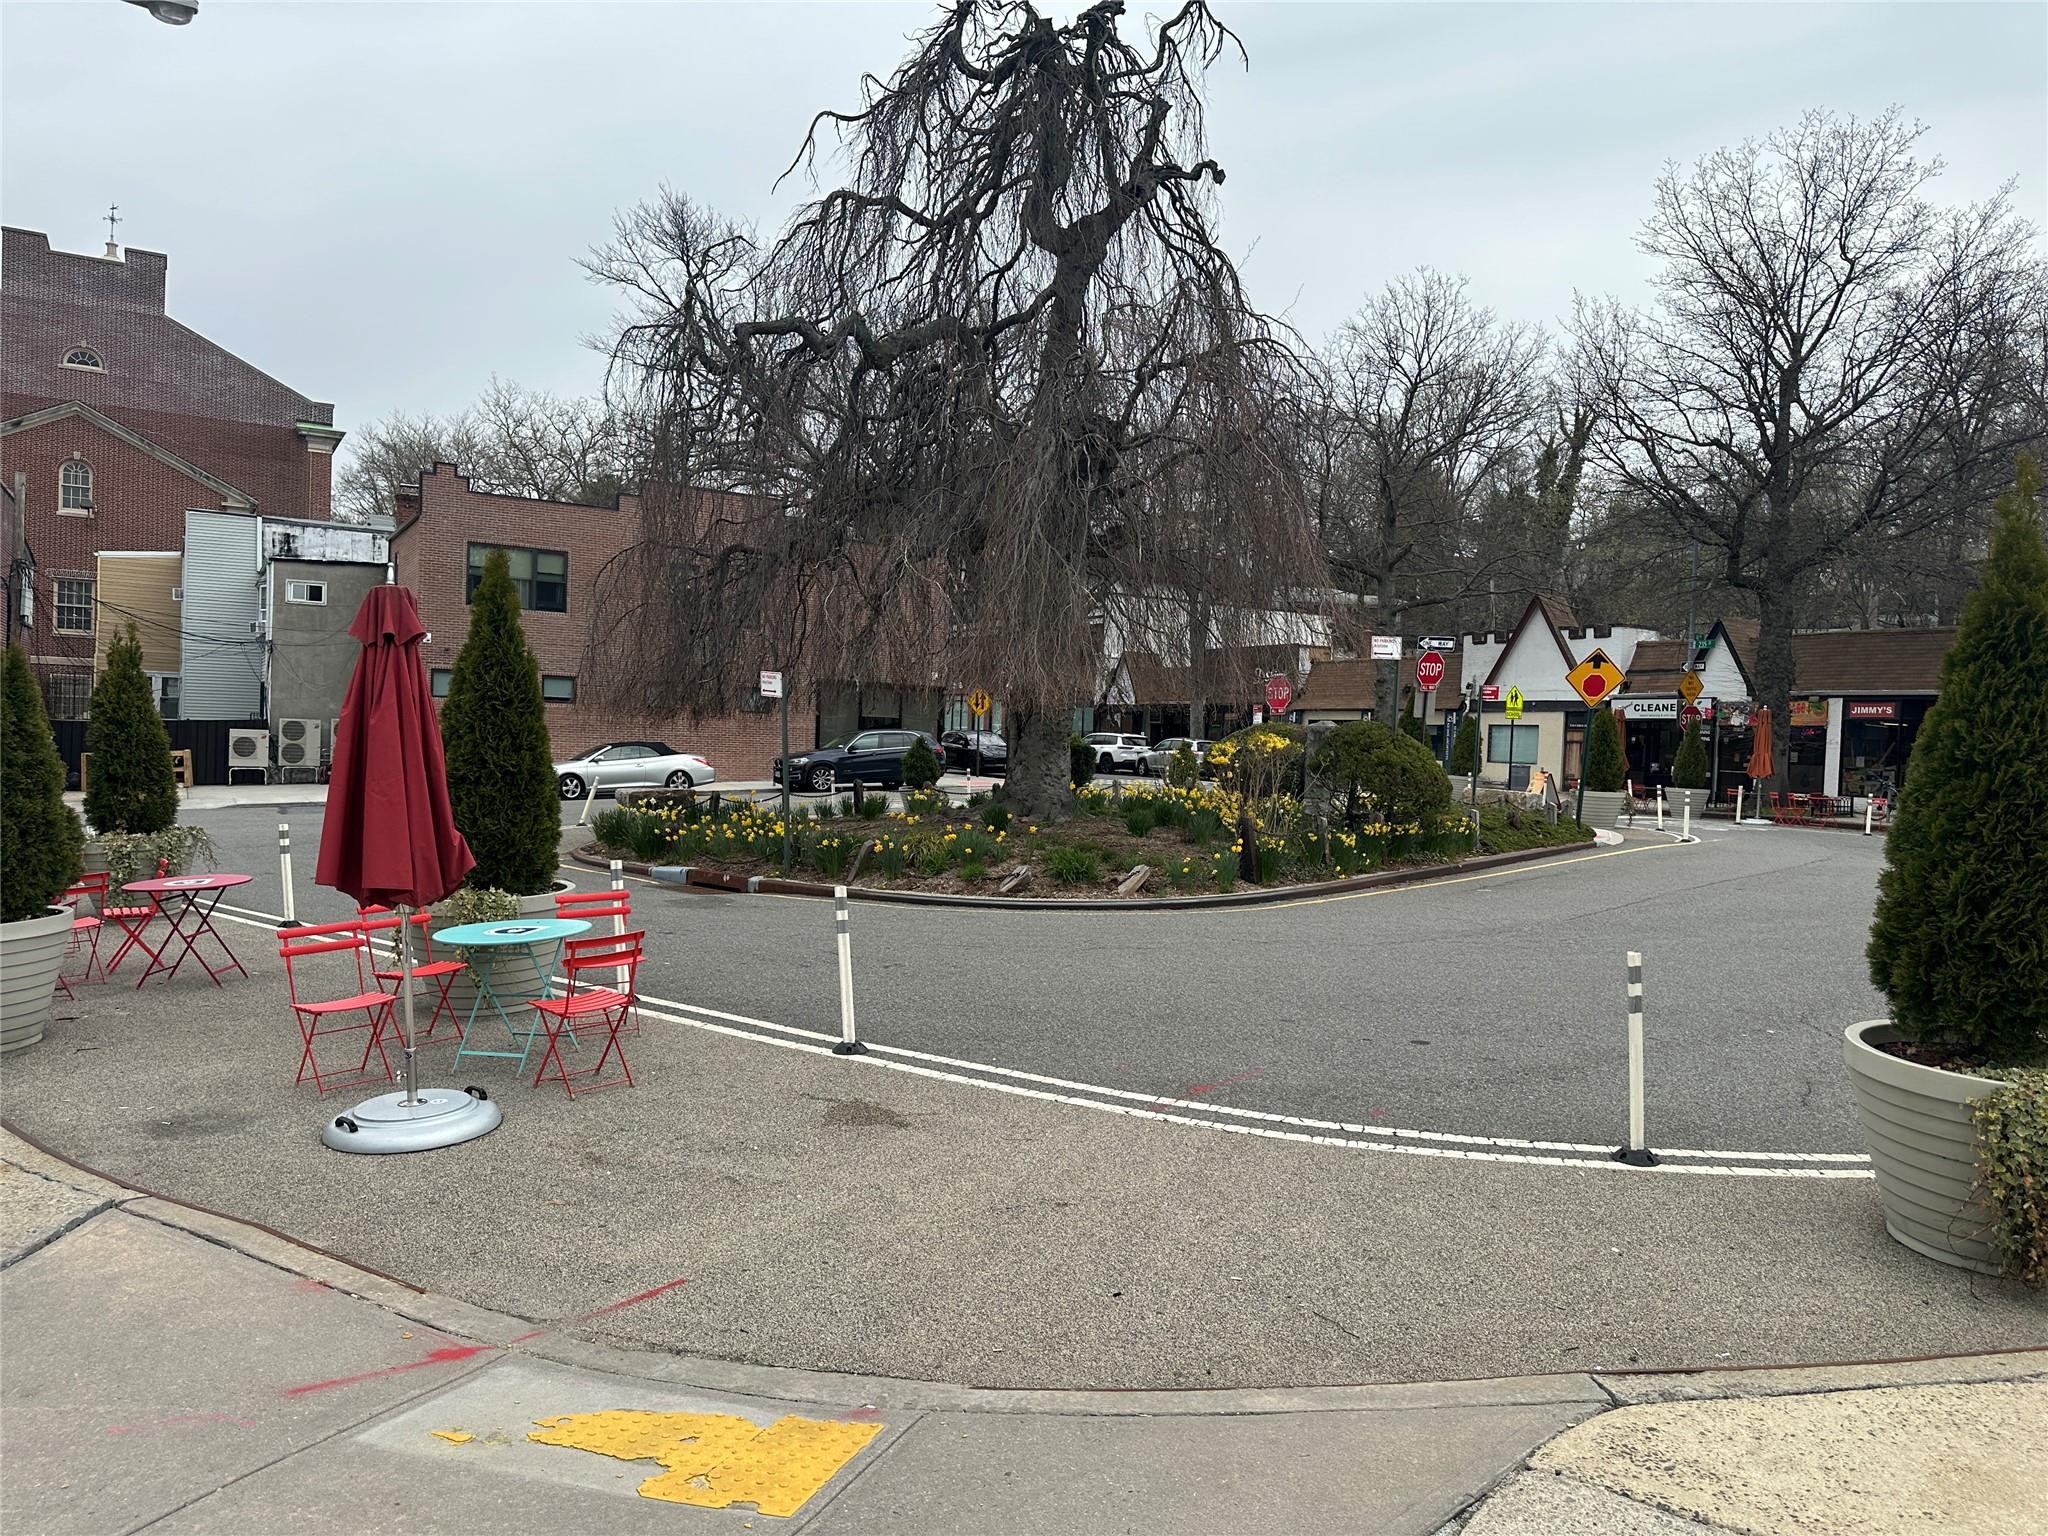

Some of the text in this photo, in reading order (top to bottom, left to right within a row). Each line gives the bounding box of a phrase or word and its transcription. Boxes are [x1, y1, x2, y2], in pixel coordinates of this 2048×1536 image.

[1420, 663, 1442, 676] STOP
[1268, 687, 1289, 700] STOP
[1851, 706, 1893, 714] JIMMY'S
